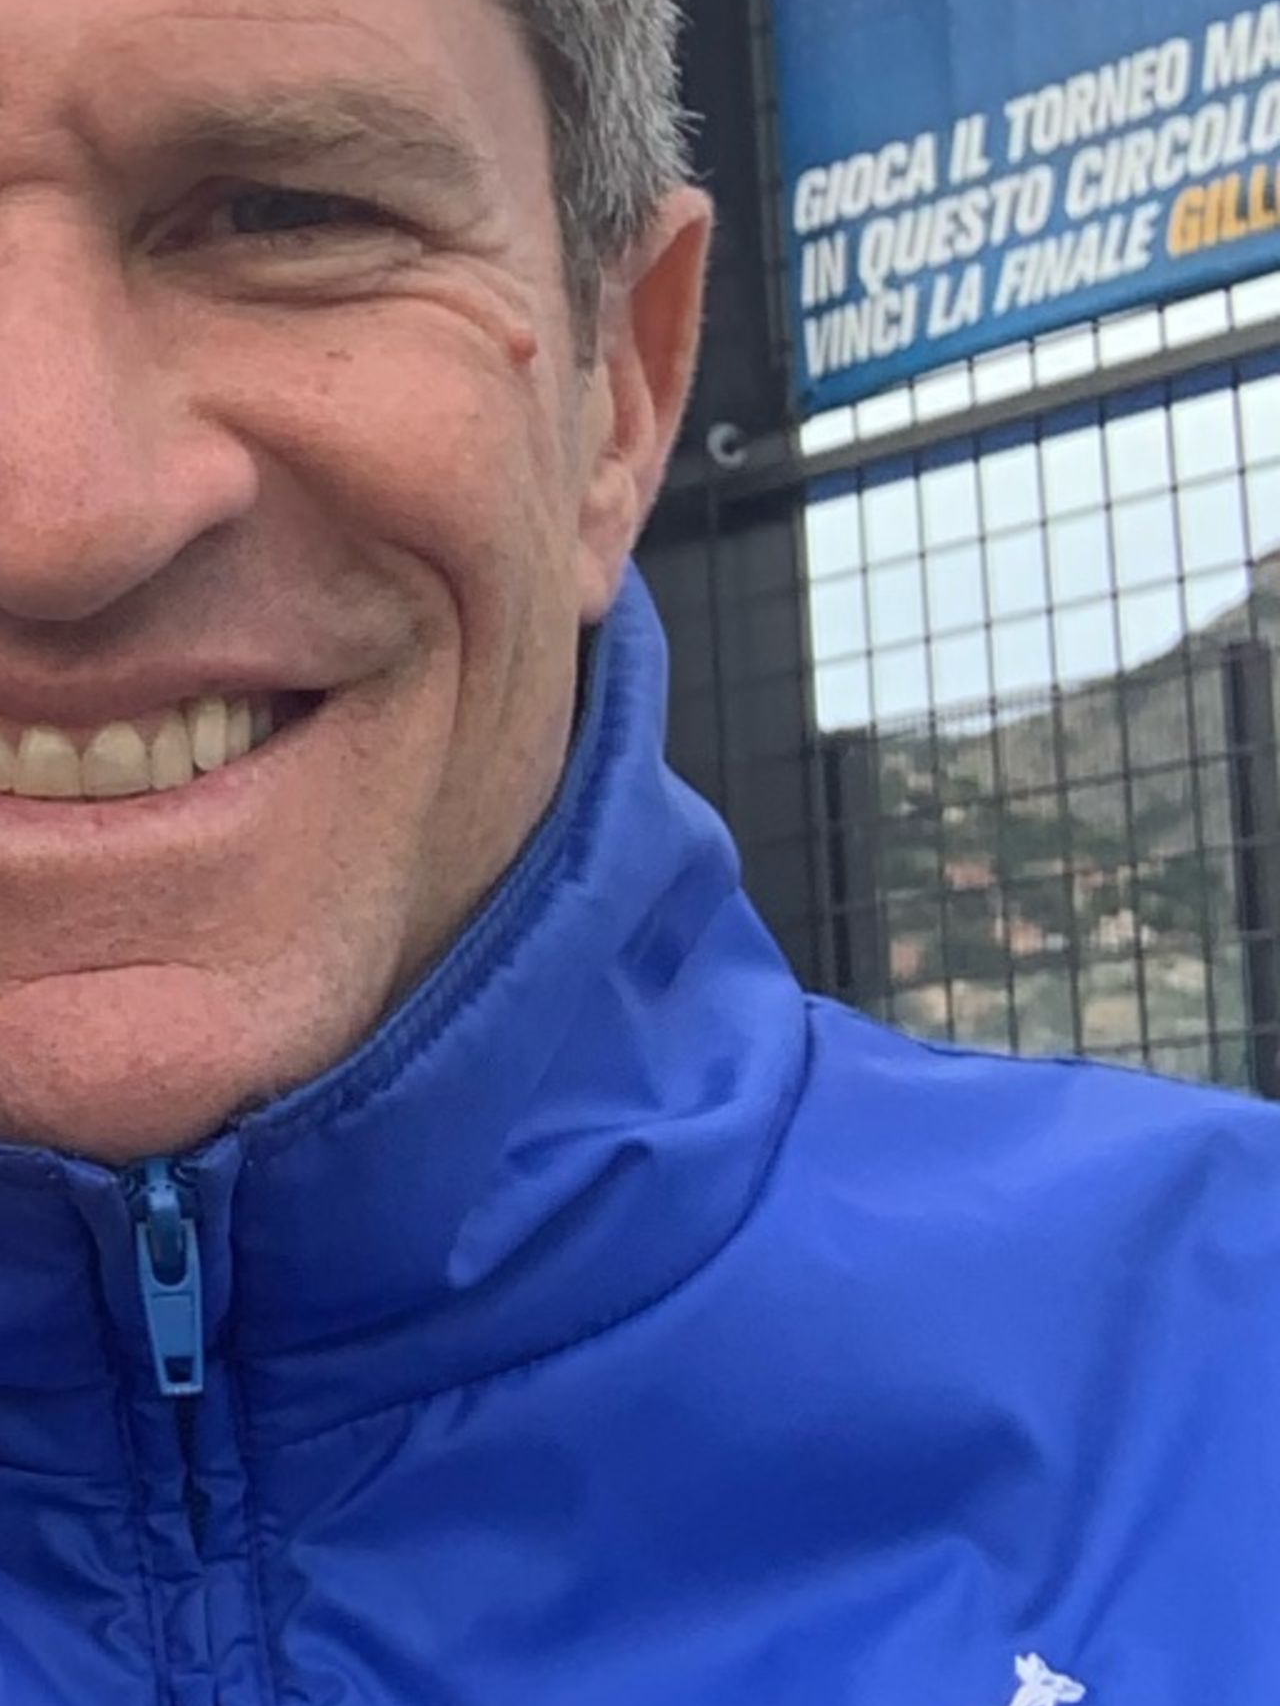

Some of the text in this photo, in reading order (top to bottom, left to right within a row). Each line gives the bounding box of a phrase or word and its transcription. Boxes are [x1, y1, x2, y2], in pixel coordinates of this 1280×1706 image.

[794, 132, 937, 235] GIOCA
[950, 113, 991, 184] IL
[1005, 38, 1191, 163] TORNEO
[802, 81, 1280, 309] IN QUESTO CIRCOLO
[803, 284, 919, 380] VINCI
[926, 264, 985, 339] LA
[993, 198, 1163, 316] FINALE
